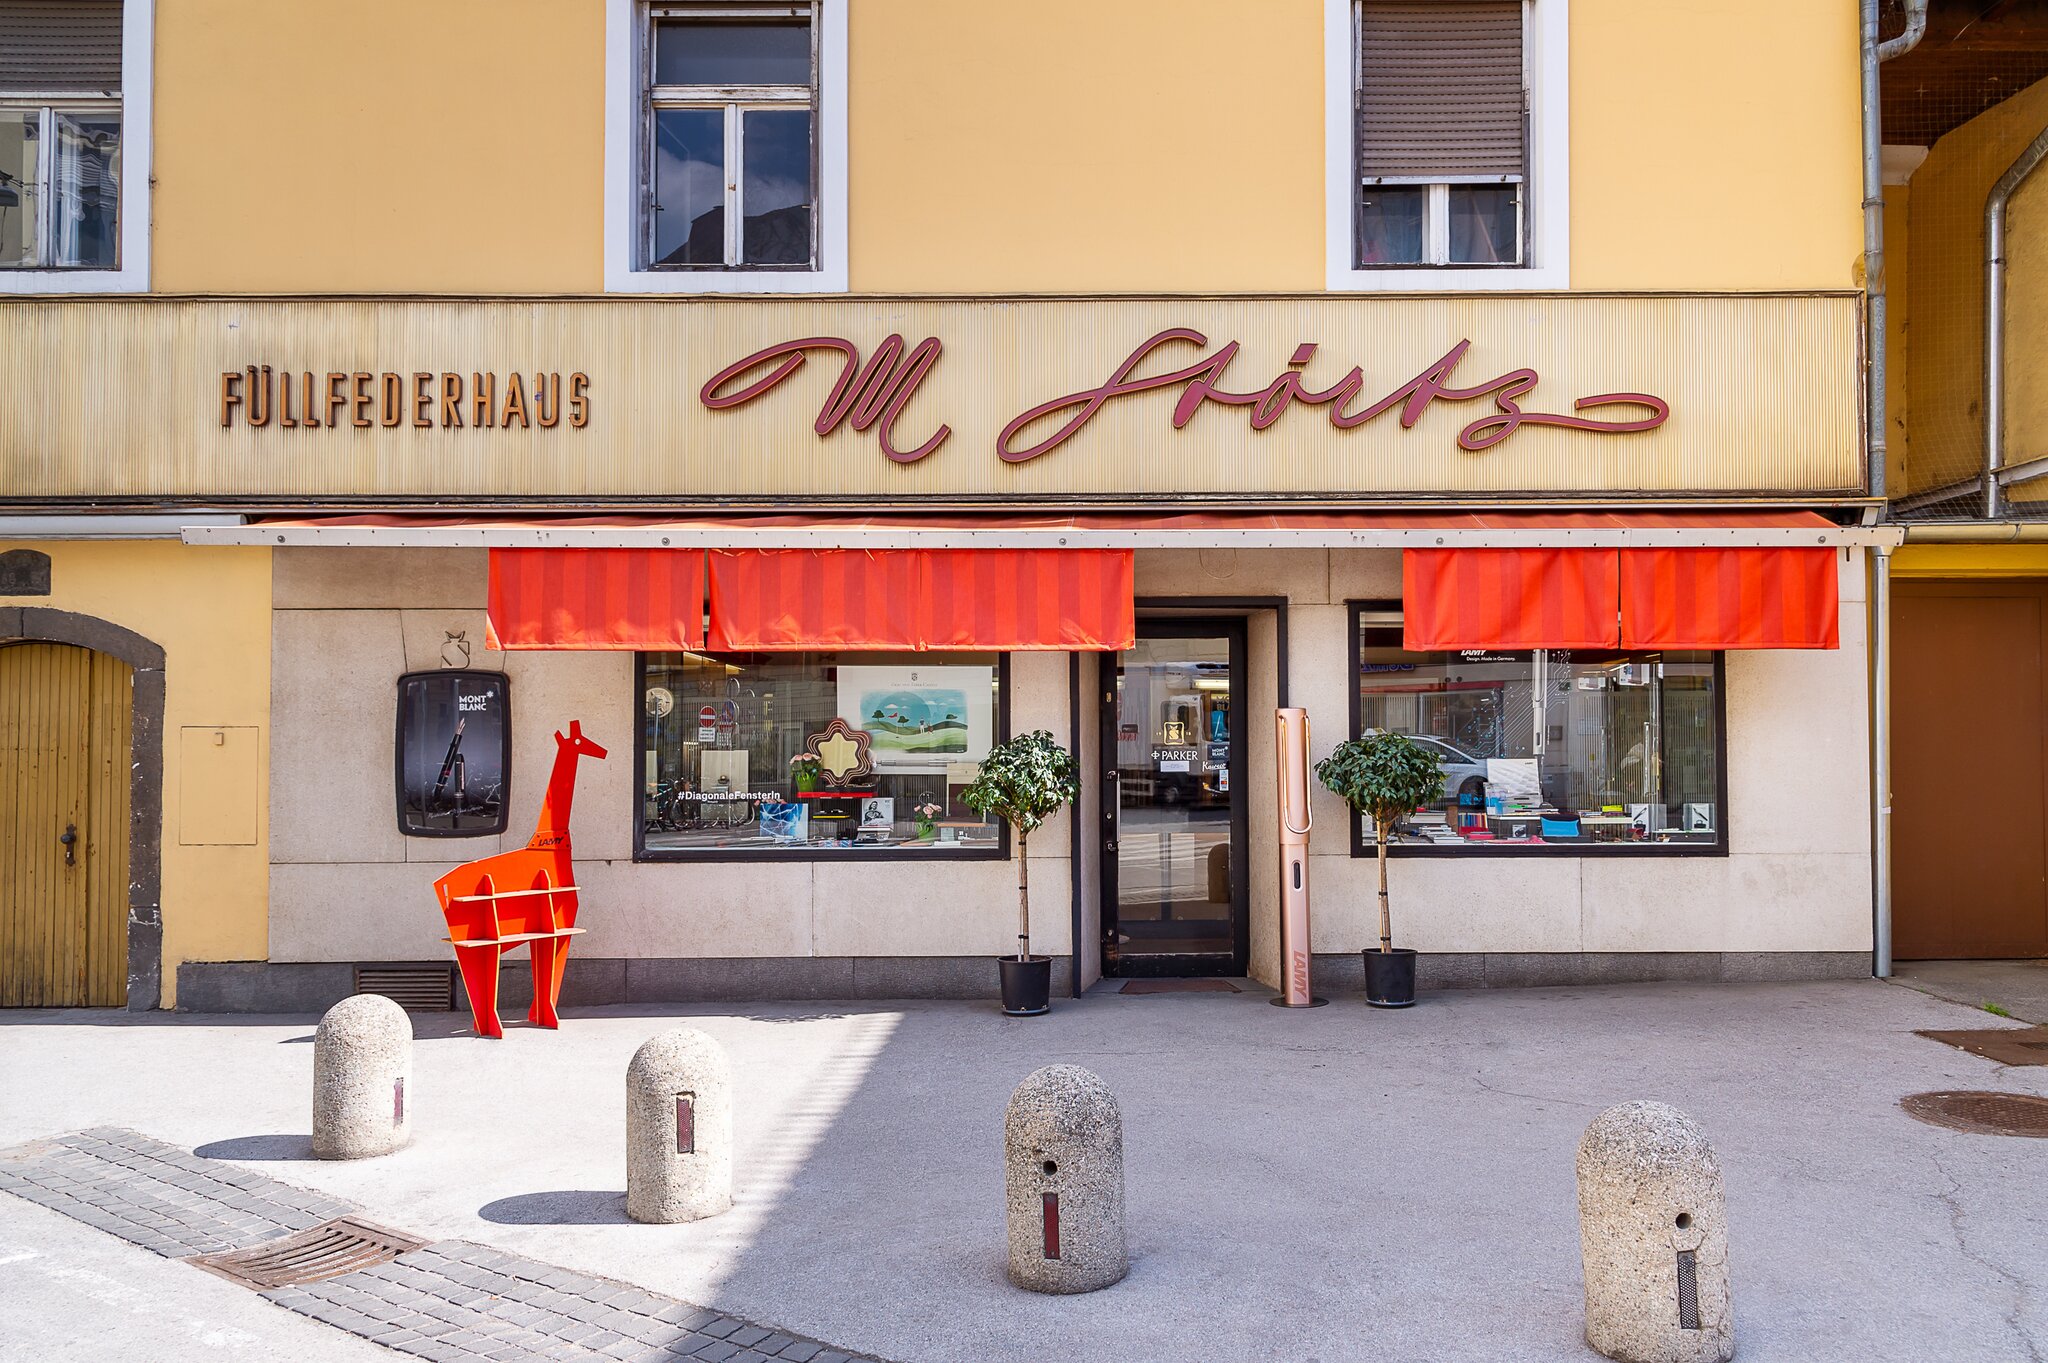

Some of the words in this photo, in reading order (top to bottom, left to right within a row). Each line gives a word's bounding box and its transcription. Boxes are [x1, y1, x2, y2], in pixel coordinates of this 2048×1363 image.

[220, 365, 590, 428] FÜLLFEDERHAUS
[458, 695, 487, 703] MONT
[458, 703, 487, 711] BLANC
[1161, 750, 1199, 760] PARKER
[677, 790, 781, 801] #DiagonaleFensterIn
[538, 836, 565, 847] LAMY
[1293, 950, 1307, 999] LAMY
